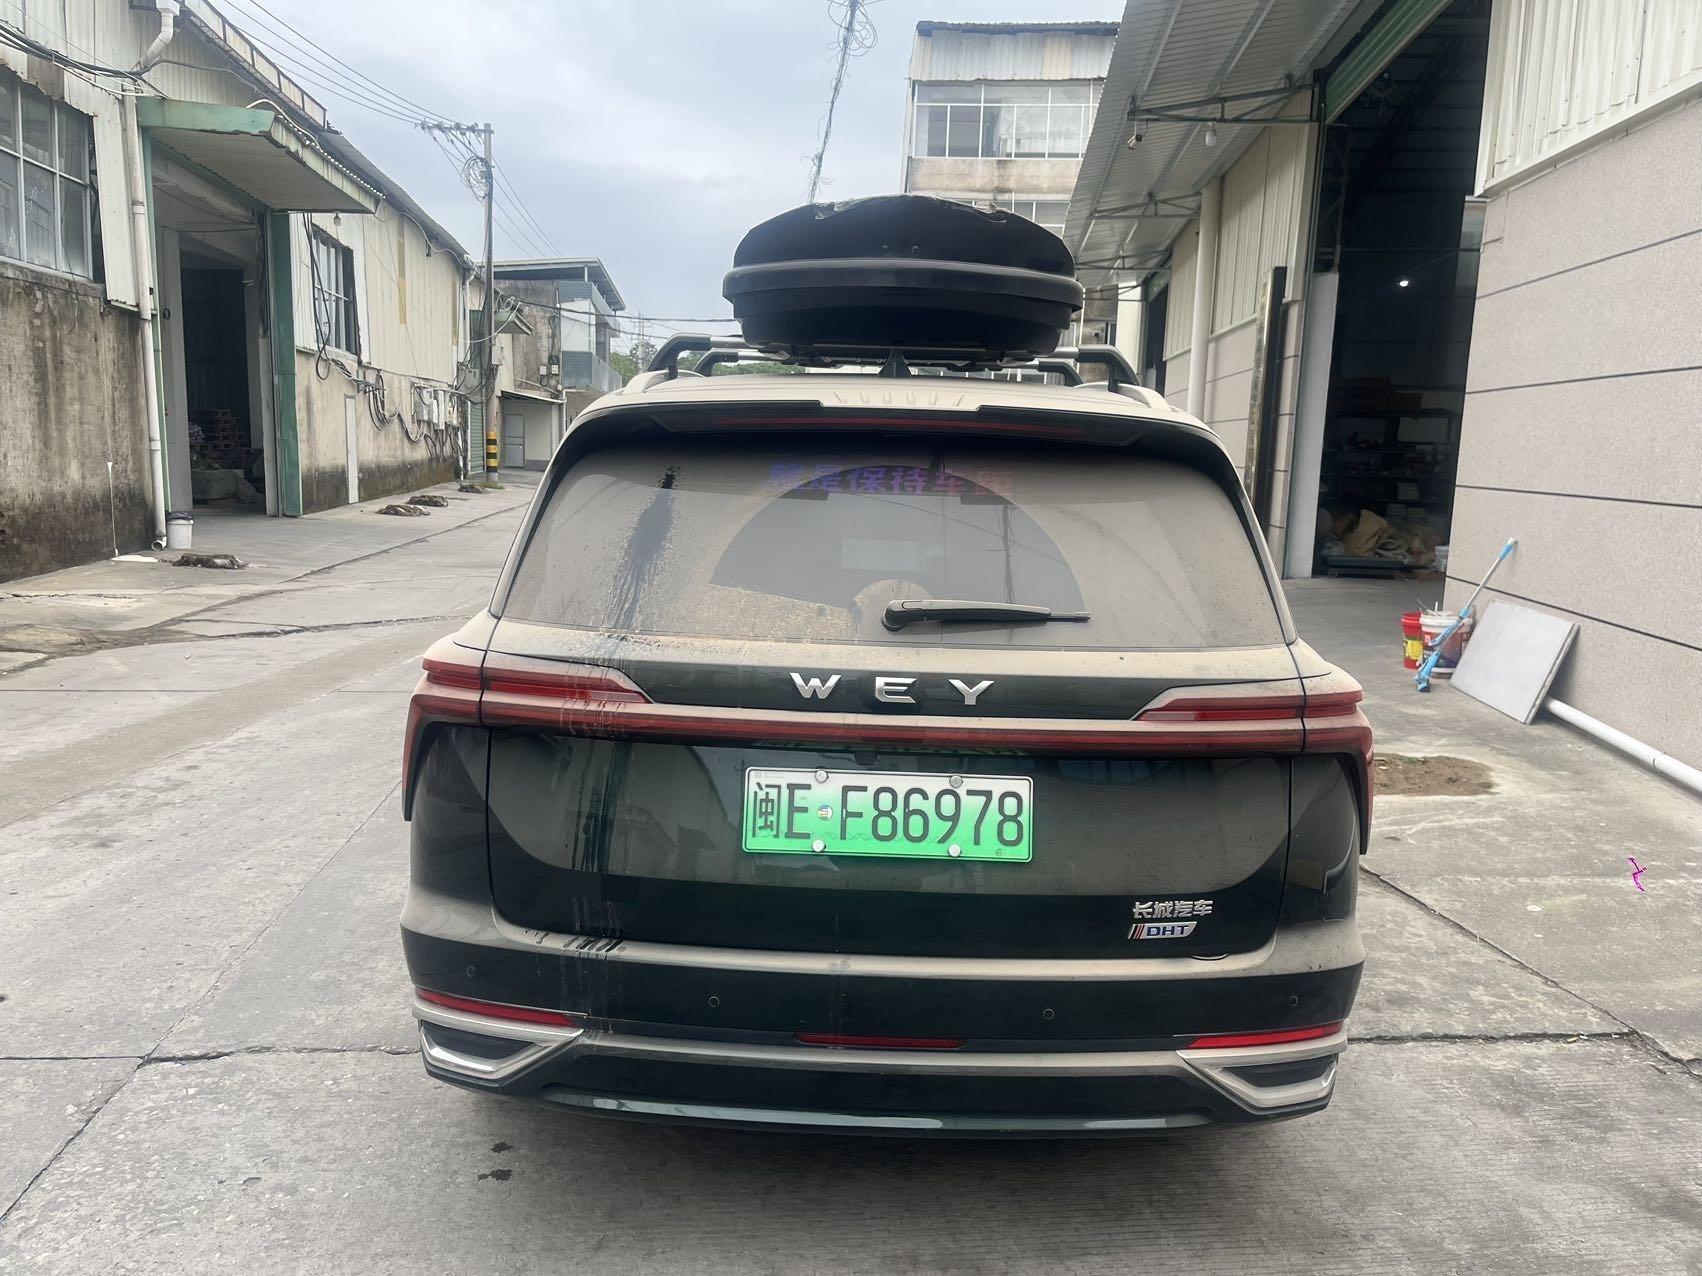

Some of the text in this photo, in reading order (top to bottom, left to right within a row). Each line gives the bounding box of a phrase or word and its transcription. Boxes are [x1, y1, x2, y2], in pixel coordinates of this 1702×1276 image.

[789, 672, 995, 706] WEY
[839, 785, 1024, 846] F86978
[1132, 899, 1214, 919] 长城汽车
[1146, 925, 1190, 937] DHT
